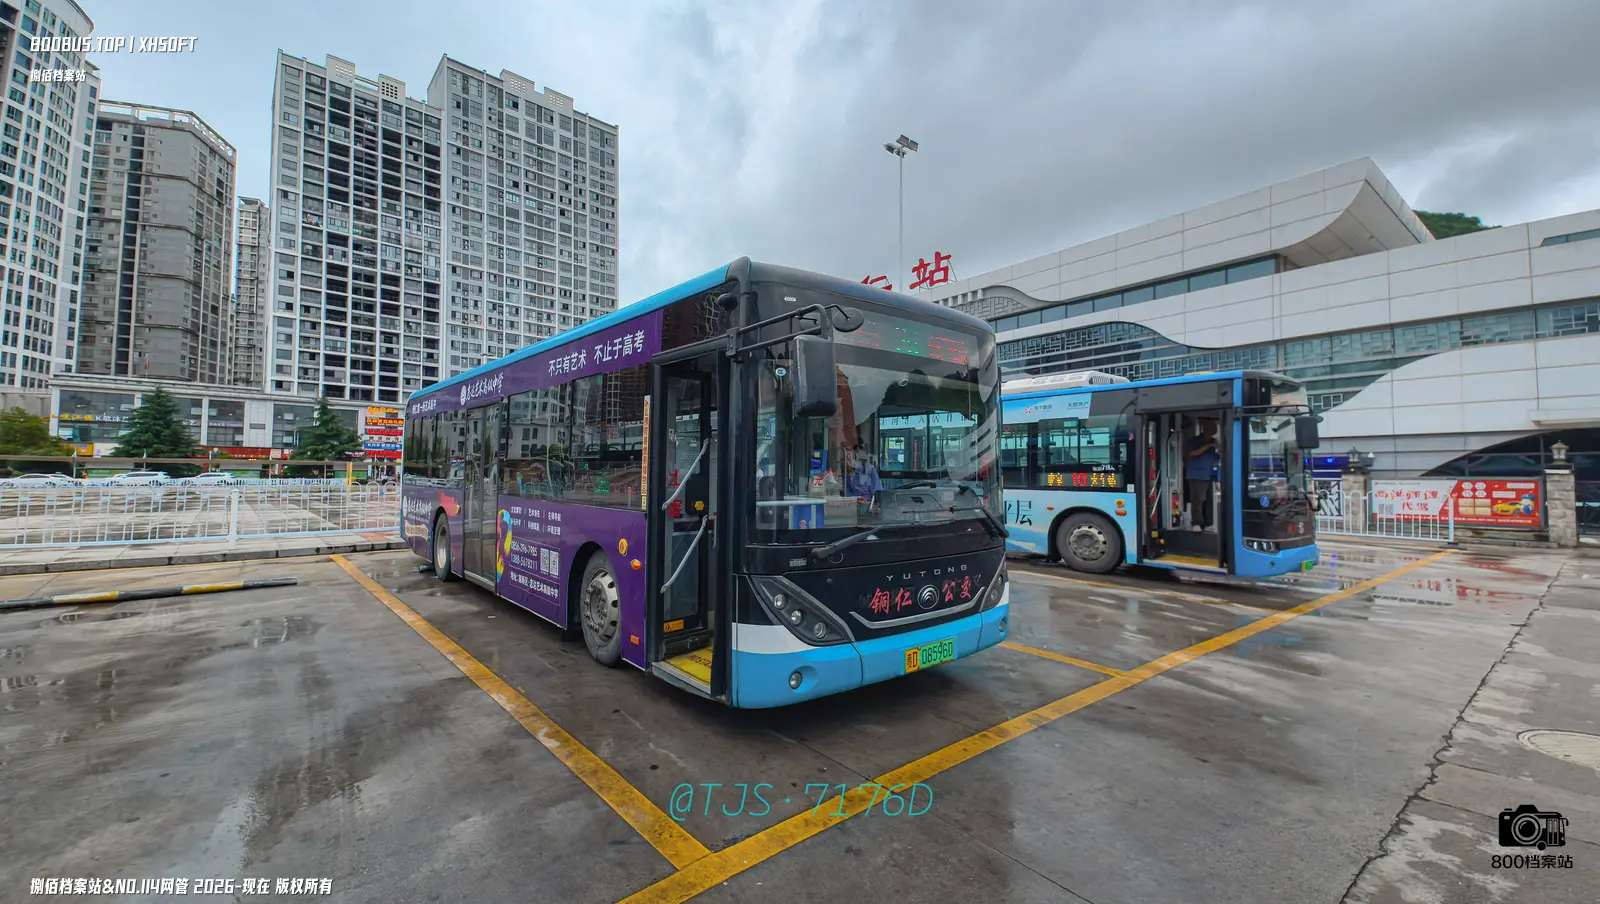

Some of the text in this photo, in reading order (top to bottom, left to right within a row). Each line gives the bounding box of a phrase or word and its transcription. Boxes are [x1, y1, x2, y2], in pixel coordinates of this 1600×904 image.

[548, 329, 645, 377] 不只有艺术 不止于高考
[1071, 472, 1088, 488] 10
[886, 564, 967, 582] YUTONG
[869, 575, 972, 614] 铜仁 公交
